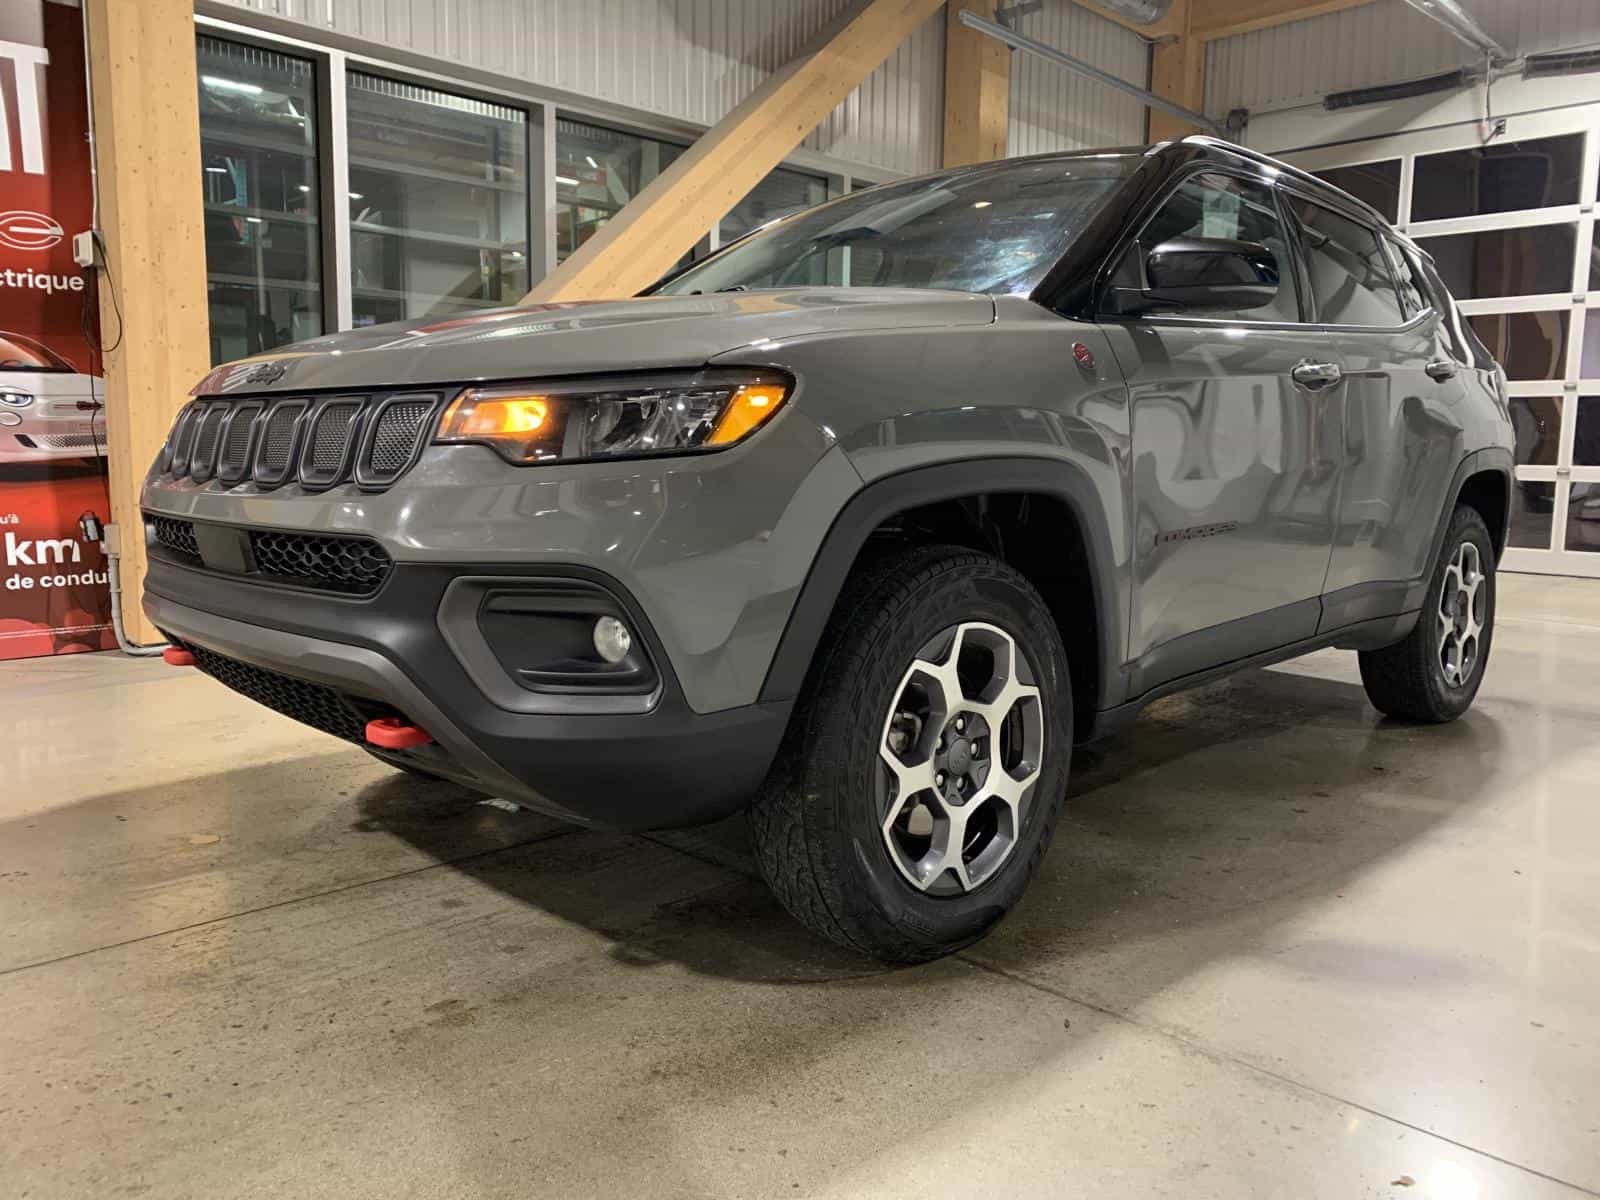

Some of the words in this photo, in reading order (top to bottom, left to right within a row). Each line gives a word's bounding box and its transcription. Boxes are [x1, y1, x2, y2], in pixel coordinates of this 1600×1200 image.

[0, 40, 50, 176] T
[5, 531, 81, 567] km
[6, 573, 35, 590] de
